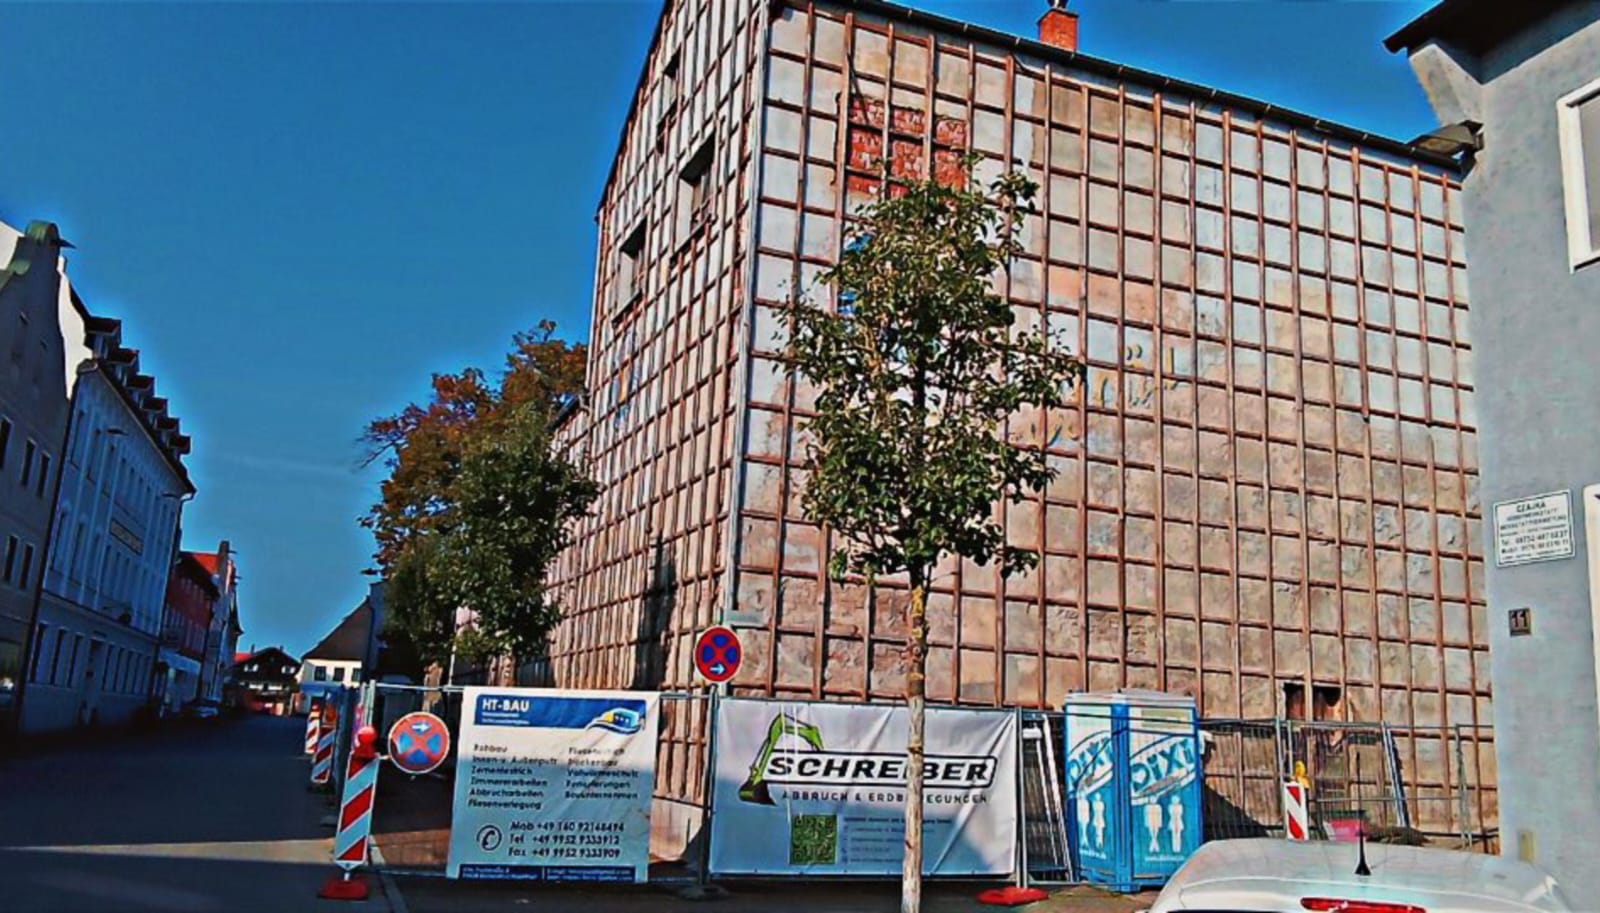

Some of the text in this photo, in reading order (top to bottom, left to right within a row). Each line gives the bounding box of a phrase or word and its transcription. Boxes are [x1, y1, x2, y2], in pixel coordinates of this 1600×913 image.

[1511, 611, 1528, 628] 11
[482, 698, 530, 712] HT-BAU
[782, 790, 848, 802] ABBRUCH
[868, 792, 987, 804] ERDBEGUNGEN
[533, 834, 550, 844] +49
[532, 847, 550, 857] +49
